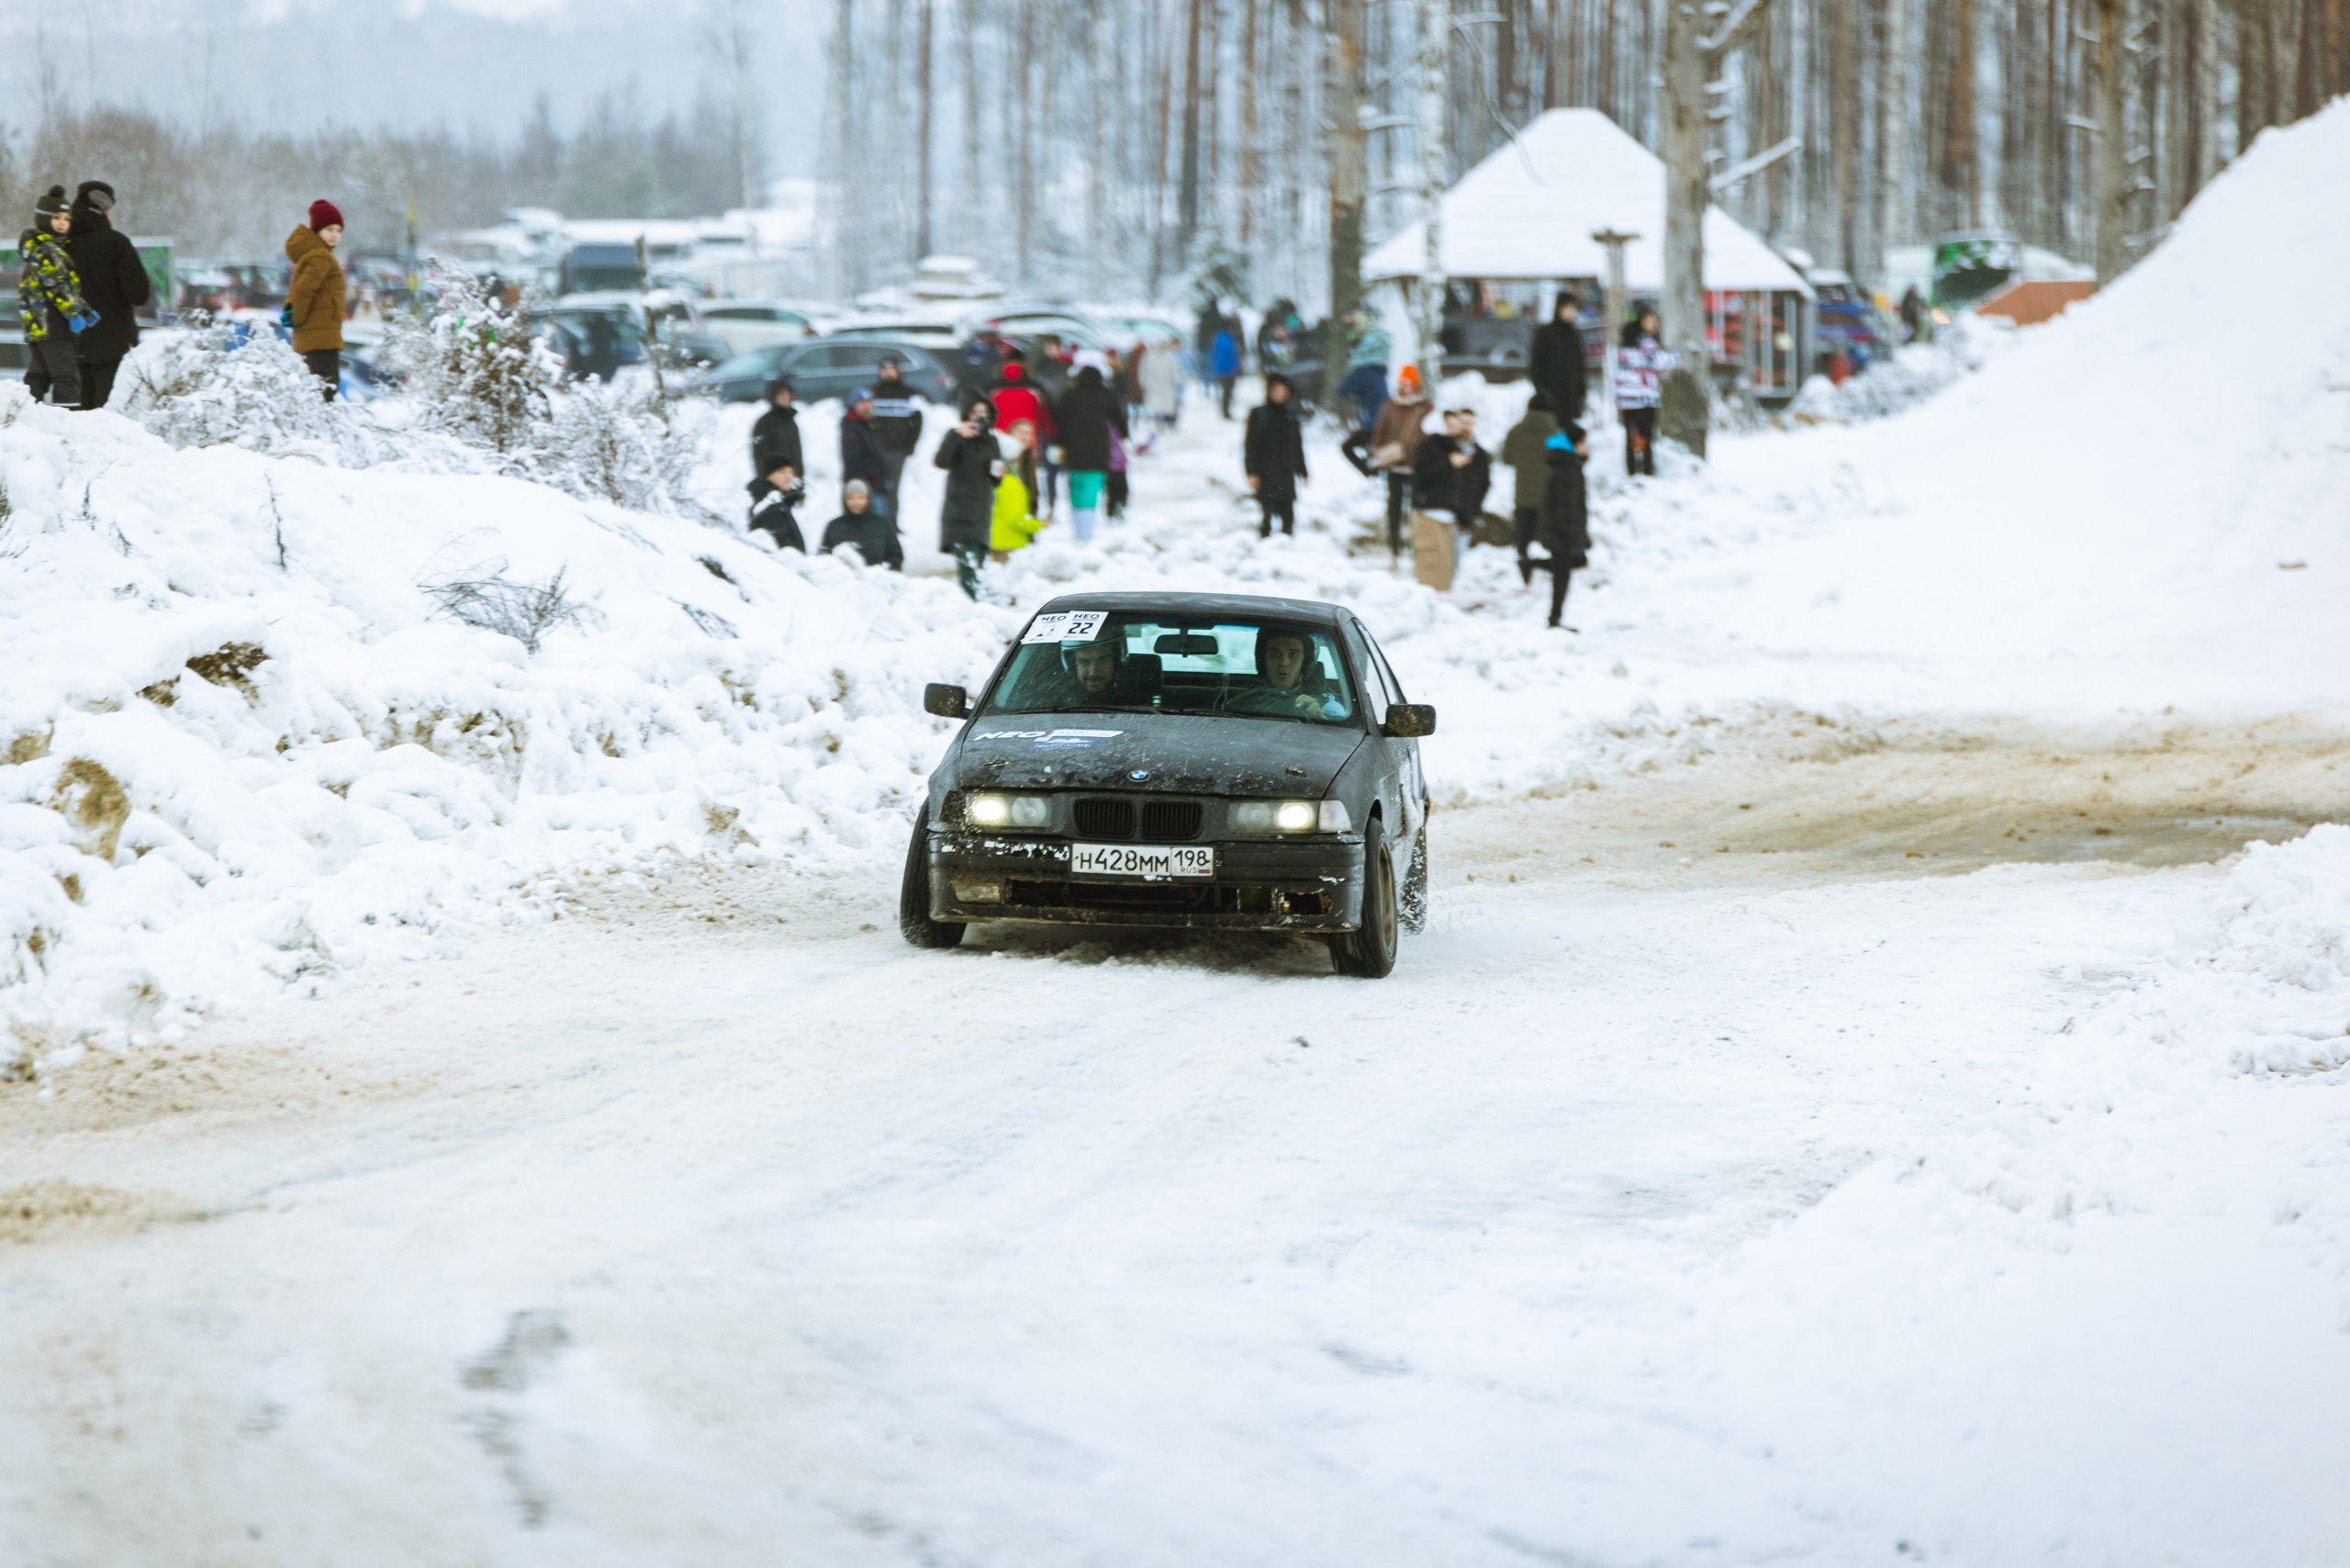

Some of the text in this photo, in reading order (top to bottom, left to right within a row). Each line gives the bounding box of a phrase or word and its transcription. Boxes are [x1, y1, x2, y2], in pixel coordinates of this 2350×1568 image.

[1067, 622, 1094, 634] 22
[972, 731, 1046, 742] NEO
[1173, 850, 1207, 867] 198
